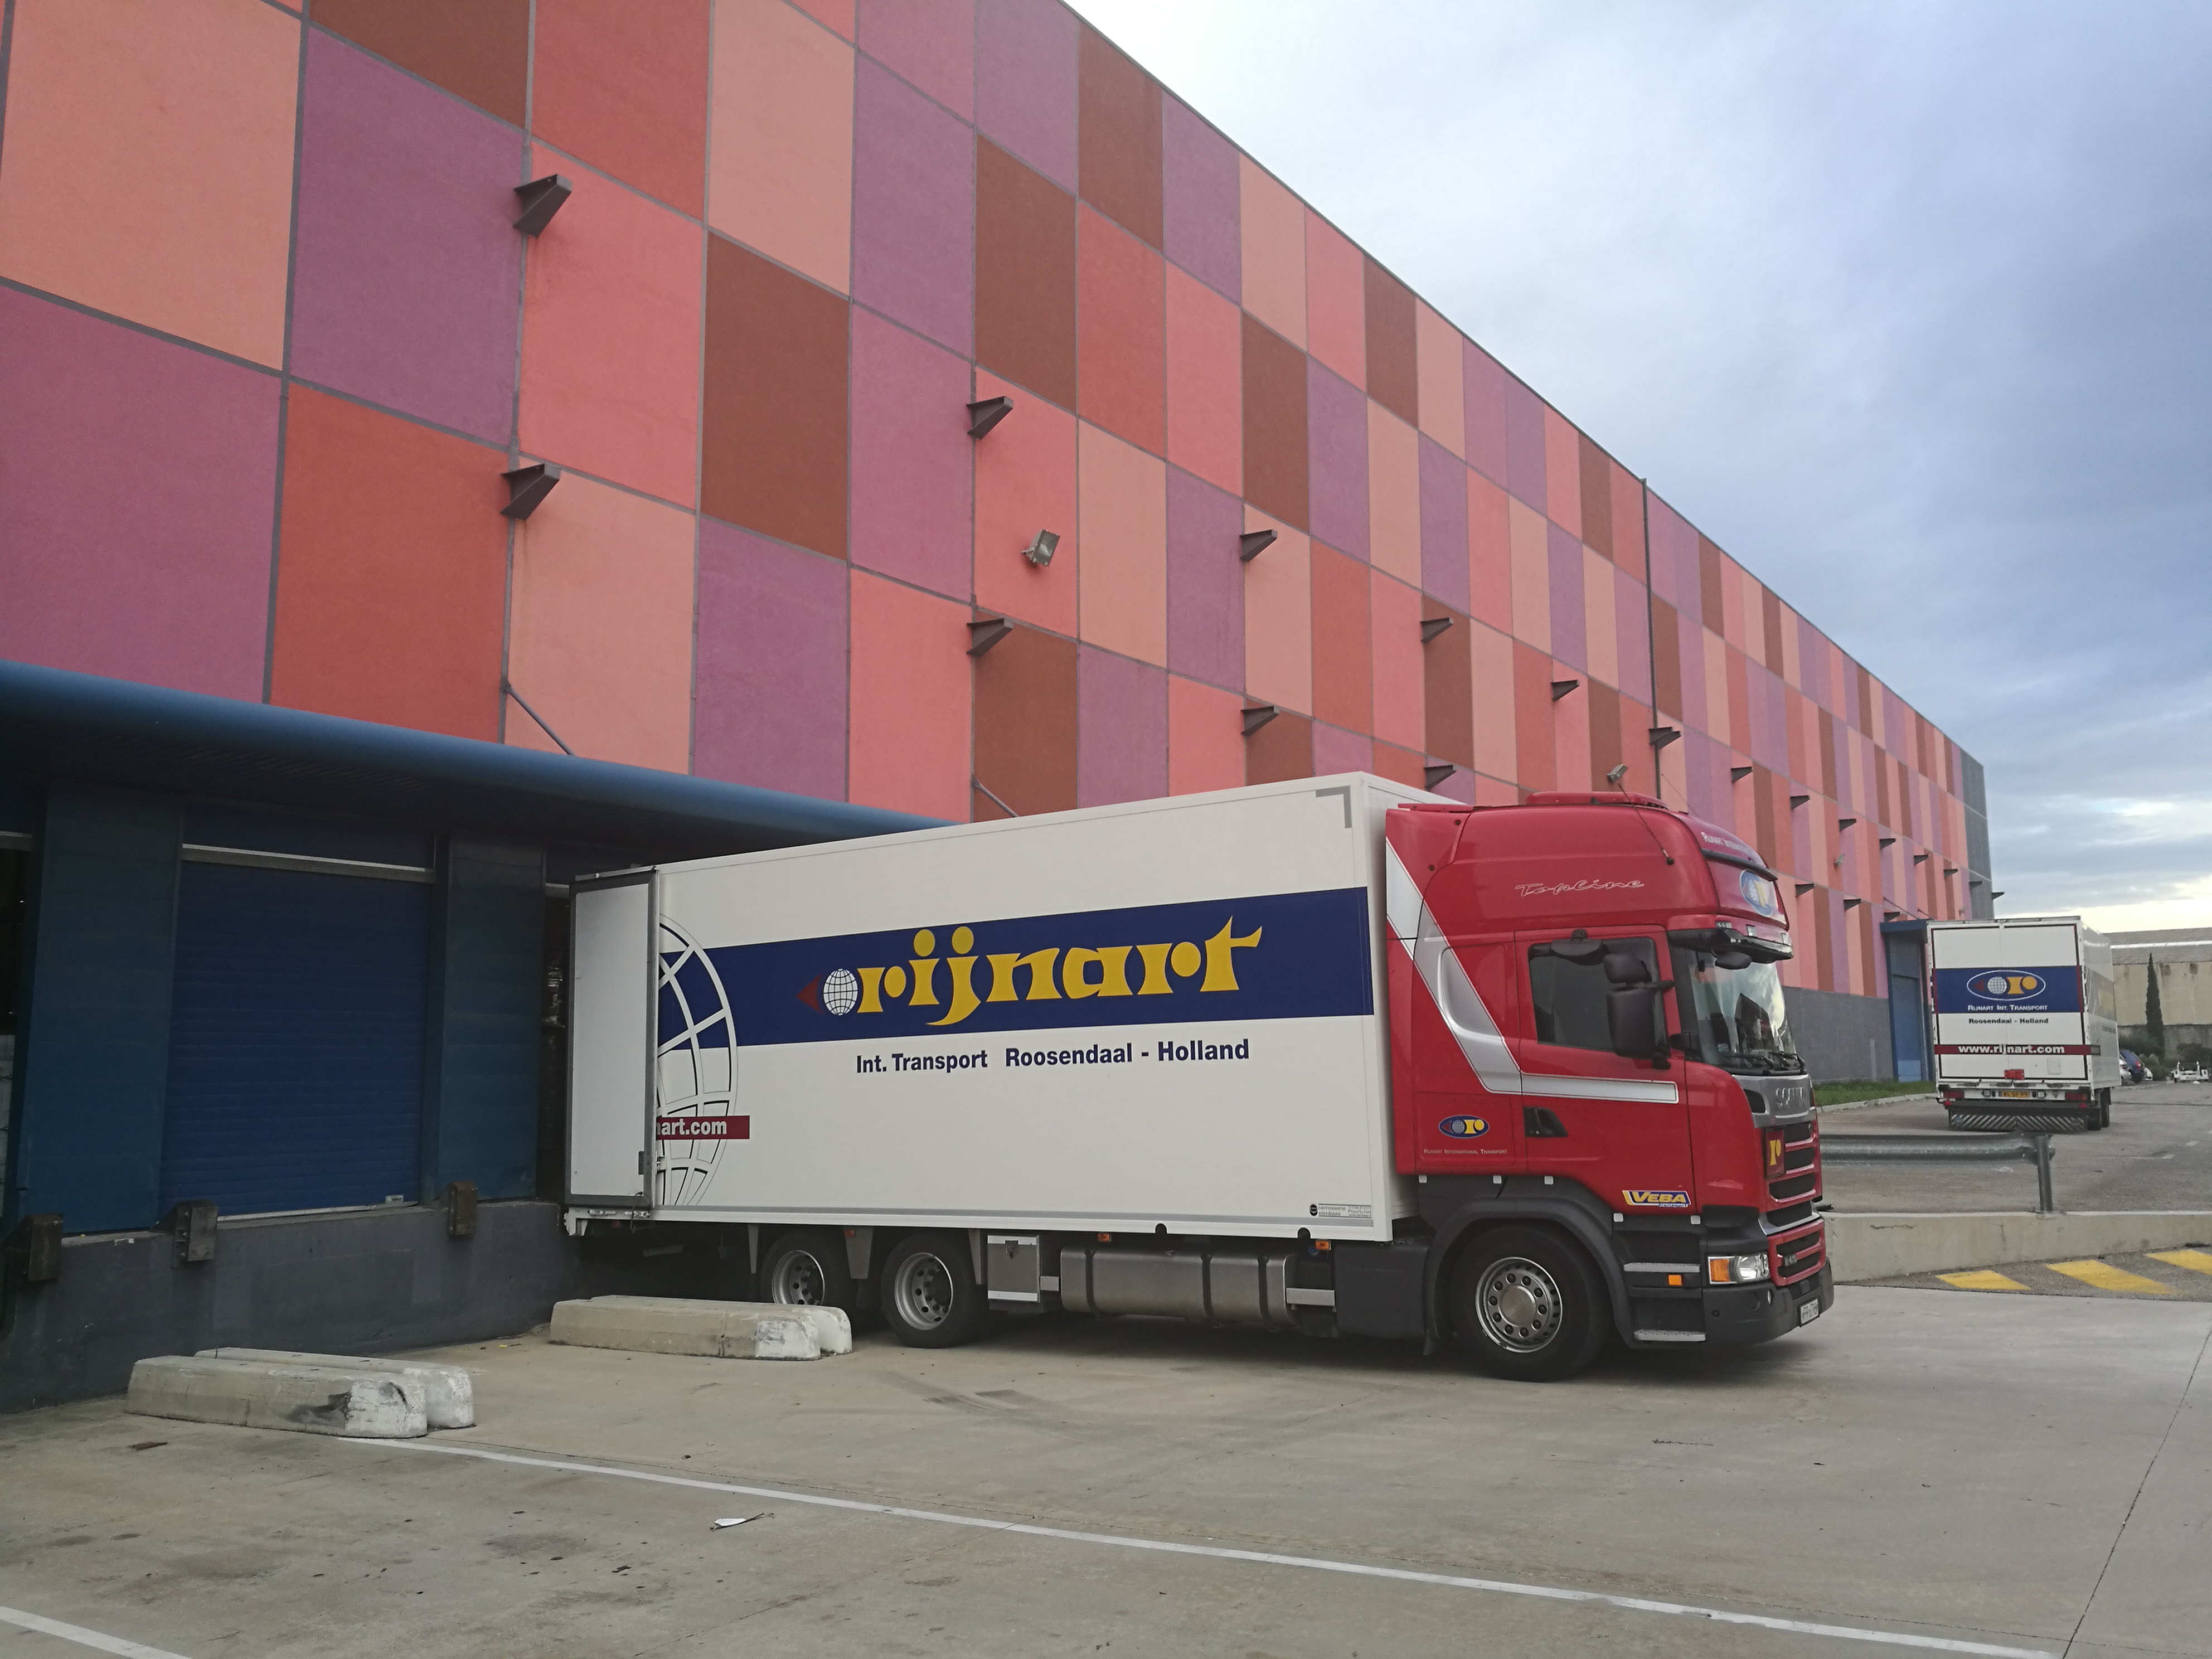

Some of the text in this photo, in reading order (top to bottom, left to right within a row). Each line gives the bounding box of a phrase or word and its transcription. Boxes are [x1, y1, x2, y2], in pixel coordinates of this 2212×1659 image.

[1515, 879, 1645, 897] Topline
[857, 915, 1262, 1026] rijnart
[857, 1055, 887, 1073] Int.
[891, 1050, 988, 1073] Transport
[1006, 1042, 1132, 1067] Roosendaal
[1158, 1039, 1249, 1061] Holland
[1958, 1044, 2065, 1054] www.rijnart.com
[1632, 1191, 1687, 1202] VEBA
